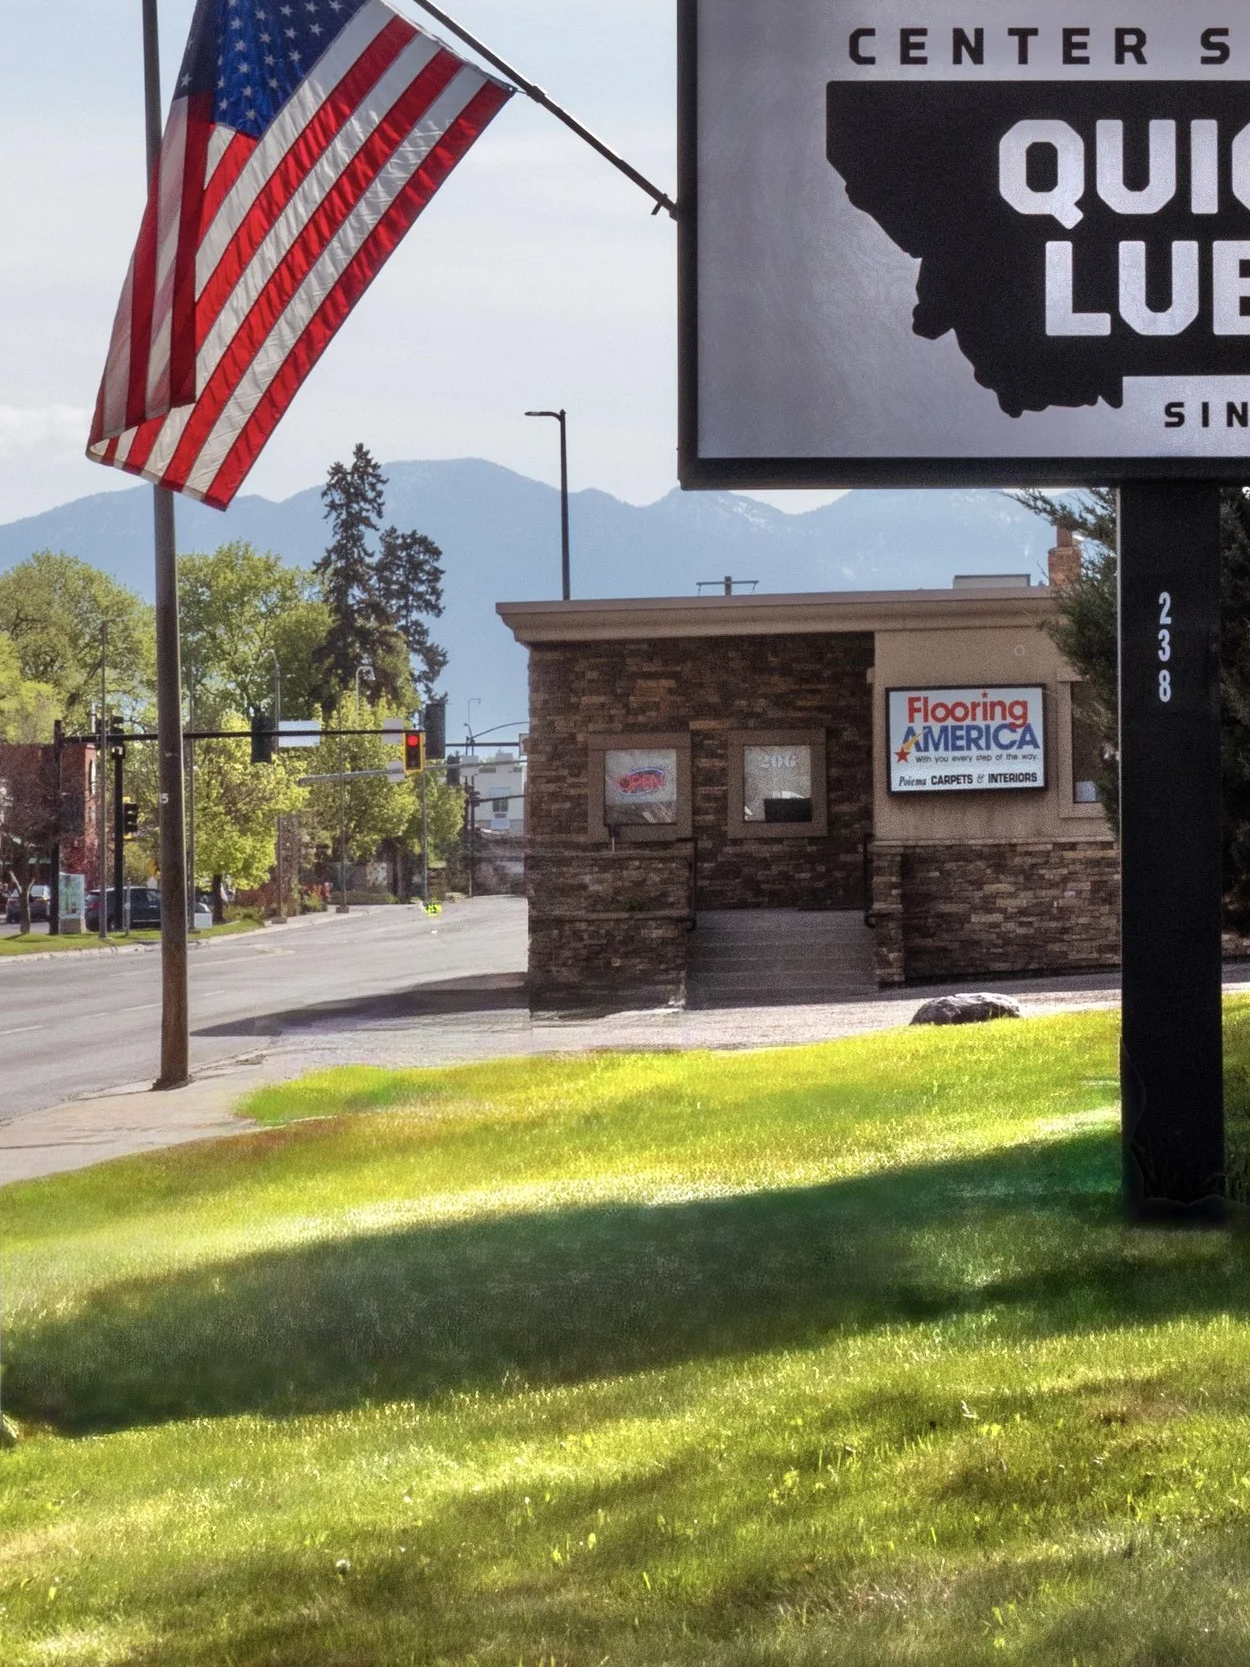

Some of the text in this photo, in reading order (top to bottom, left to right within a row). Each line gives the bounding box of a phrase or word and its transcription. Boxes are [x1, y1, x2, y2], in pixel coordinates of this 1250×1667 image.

[850, 28, 1148, 66] CENTER
[1158, 591, 1172, 703] 238
[907, 695, 1028, 729] Flooring
[902, 722, 1041, 752] AMERICA
[915, 754, 932, 763] With
[934, 755, 949, 764] you
[951, 754, 973, 764] every
[975, 753, 992, 763] step
[995, 753, 1004, 761] of
[1005, 752, 1018, 760] the
[930, 774, 973, 786] CARPETS
[987, 772, 1038, 784] INTERIORS
